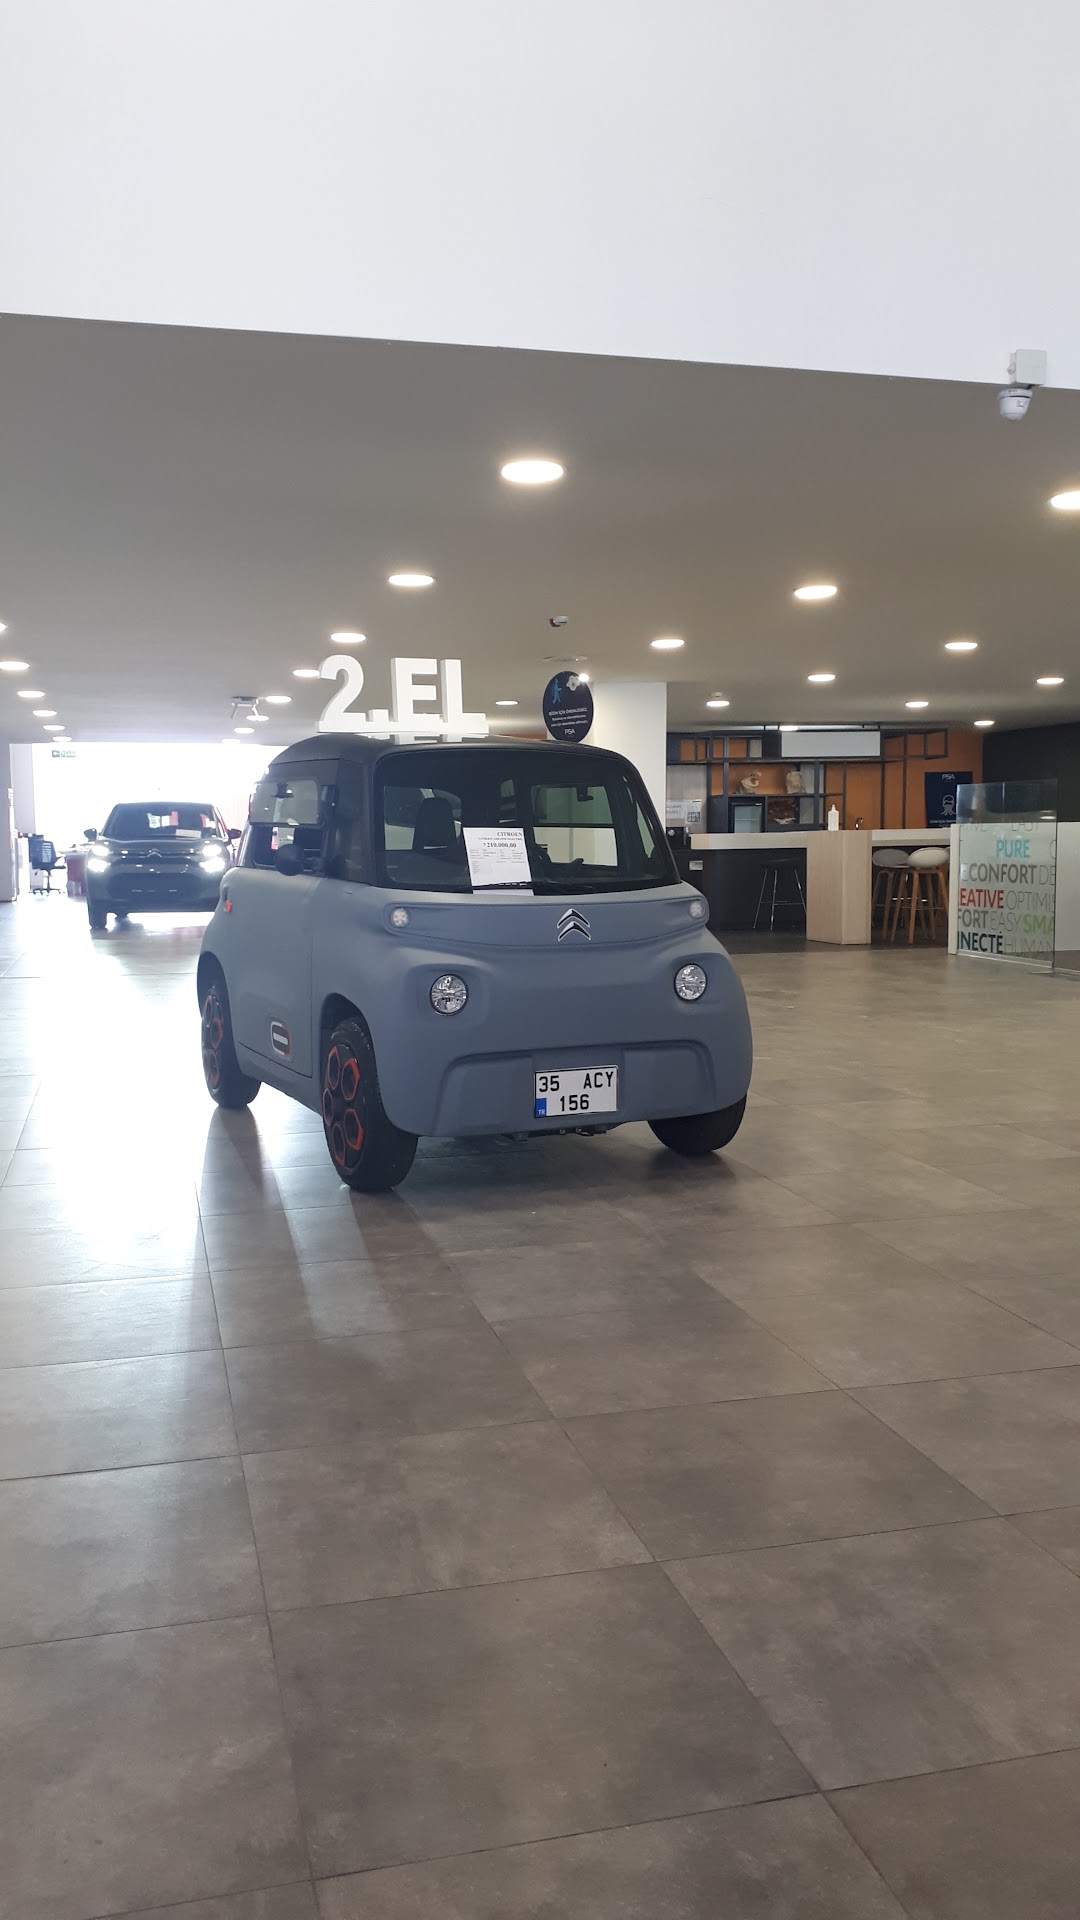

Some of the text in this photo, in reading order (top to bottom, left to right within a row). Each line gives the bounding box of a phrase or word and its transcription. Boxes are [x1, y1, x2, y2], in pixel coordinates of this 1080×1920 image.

[317, 654, 488, 734] 2.EL
[996, 839, 1031, 859] PURE
[969, 863, 1037, 884] CONFORT
[960, 888, 1005, 909] EATIVE
[990, 910, 1021, 932] EASY
[538, 1071, 614, 1092] 35 ACY
[559, 1093, 589, 1112] 156
